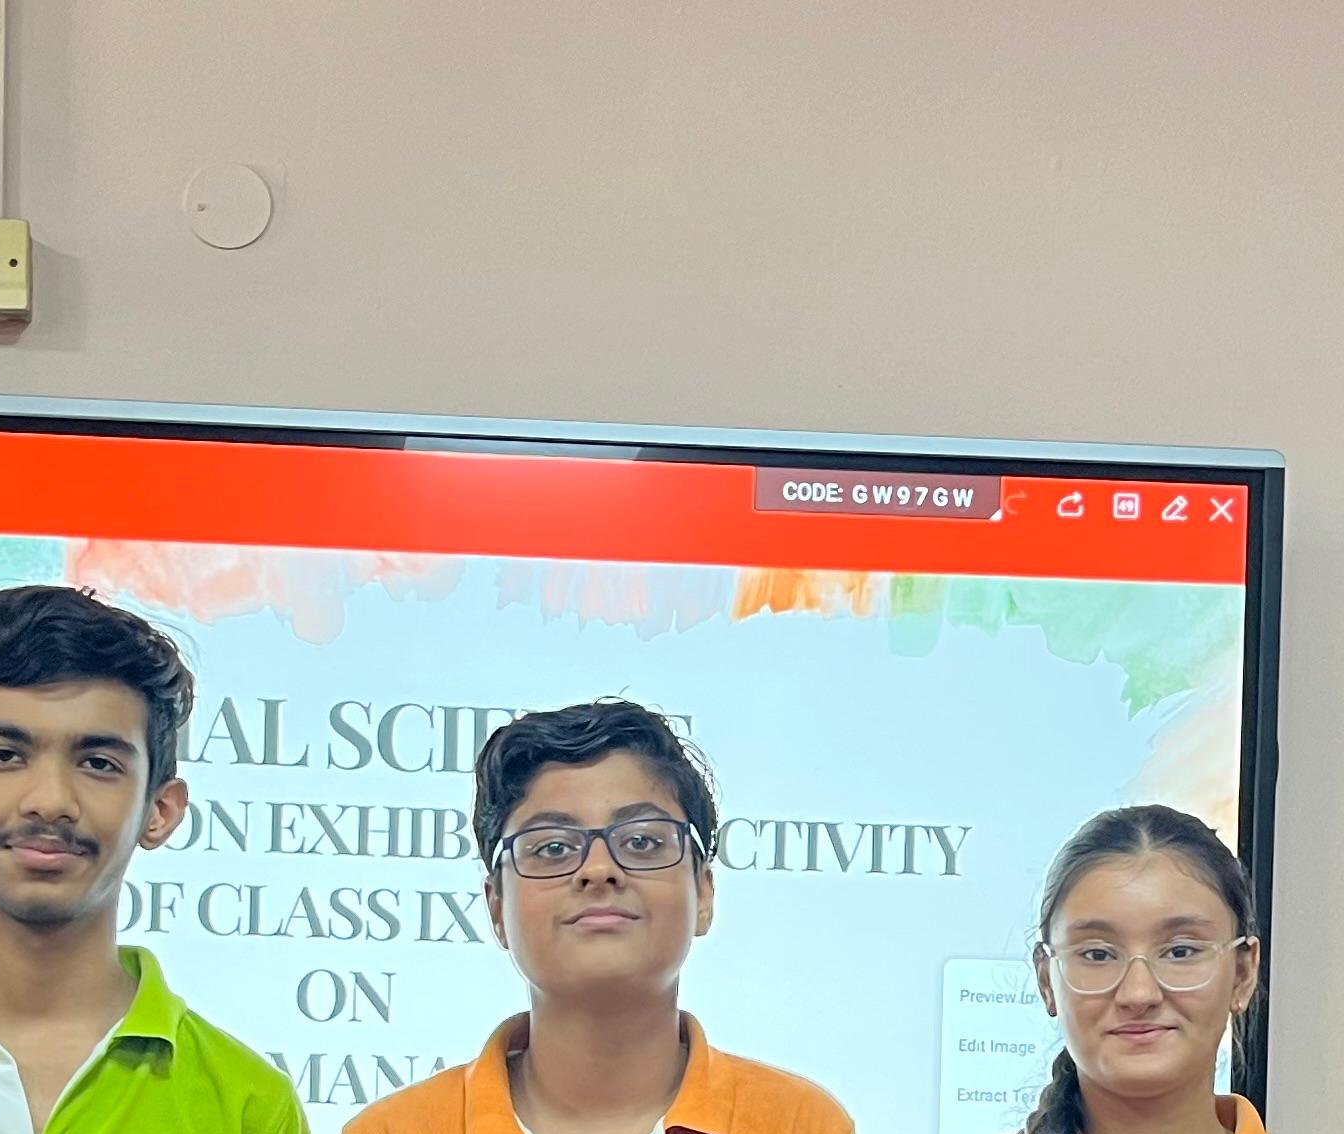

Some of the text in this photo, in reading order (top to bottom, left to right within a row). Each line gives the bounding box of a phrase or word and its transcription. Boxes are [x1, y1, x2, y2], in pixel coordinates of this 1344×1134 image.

[716, 817, 974, 877] CTIVITY
[197, 882, 401, 941] CLASS
[296, 968, 397, 1023] ON
[958, 1038, 1036, 1057] Edit Image
[957, 1087, 1008, 1103] Extract
